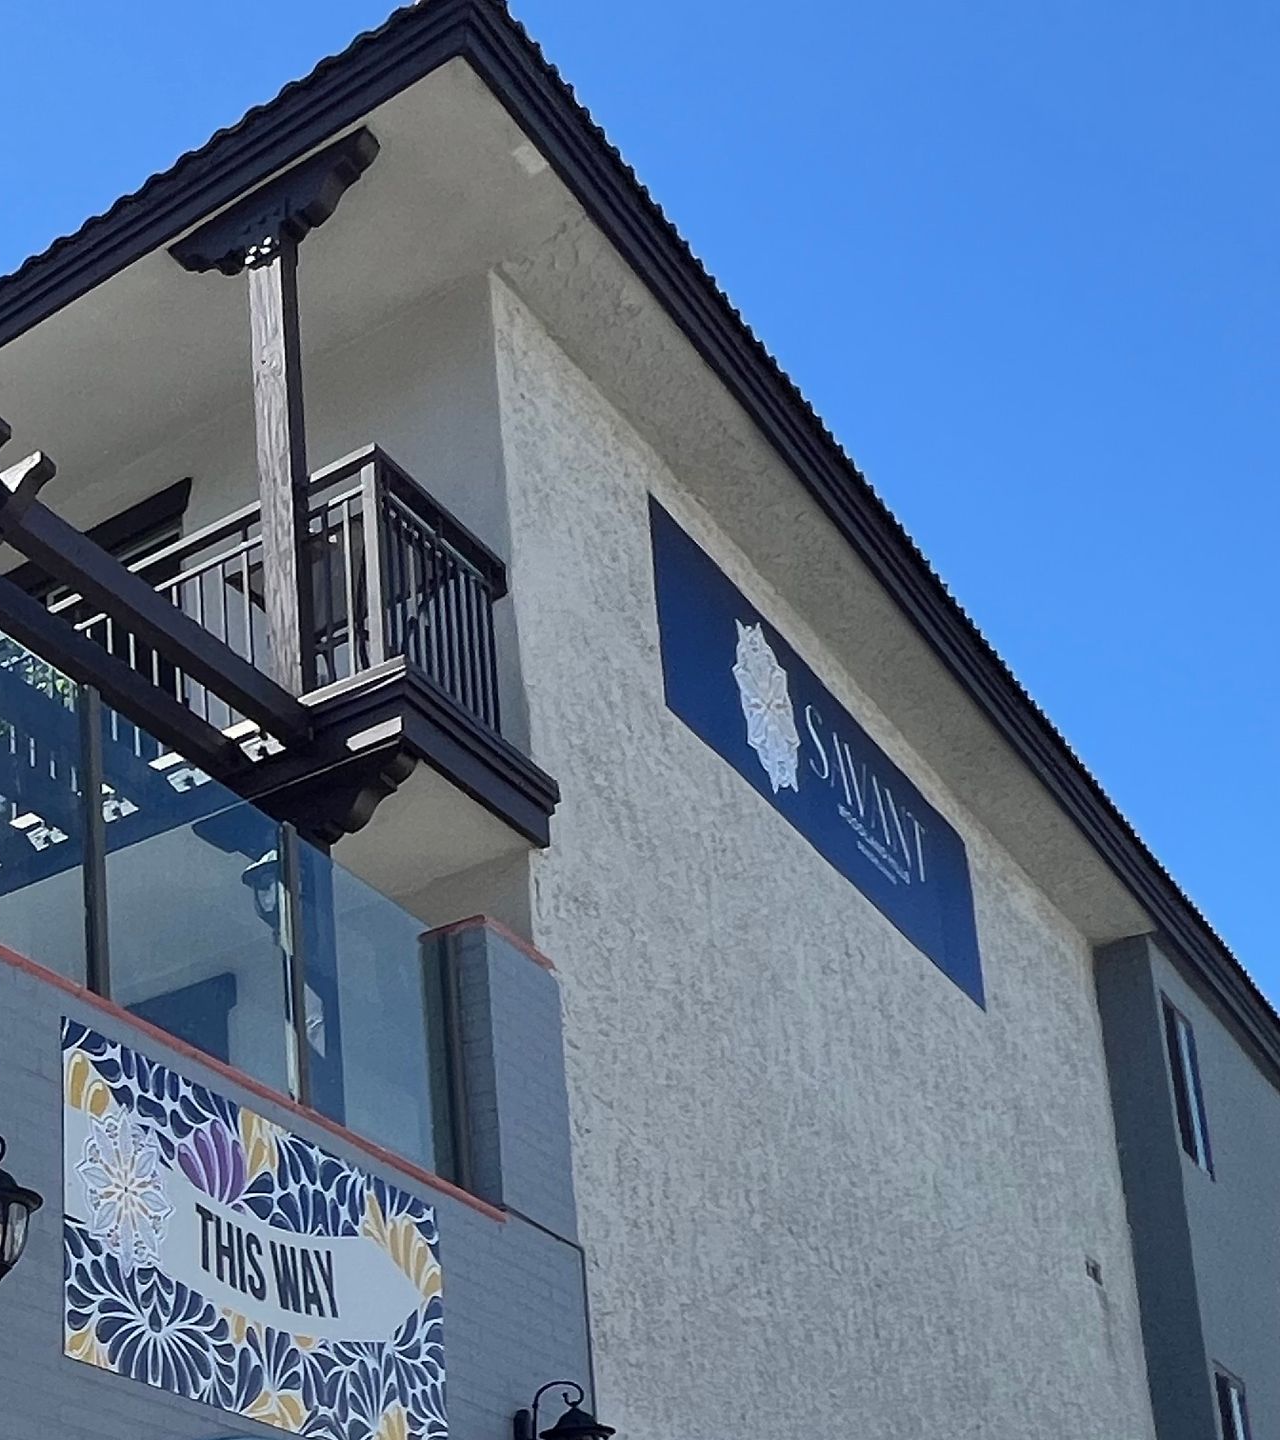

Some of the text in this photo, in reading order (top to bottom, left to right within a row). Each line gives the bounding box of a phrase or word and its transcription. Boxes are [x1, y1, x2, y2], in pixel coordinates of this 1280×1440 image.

[804, 704, 927, 882] SAVANT
[194, 1202, 340, 1320] THIS WAY
